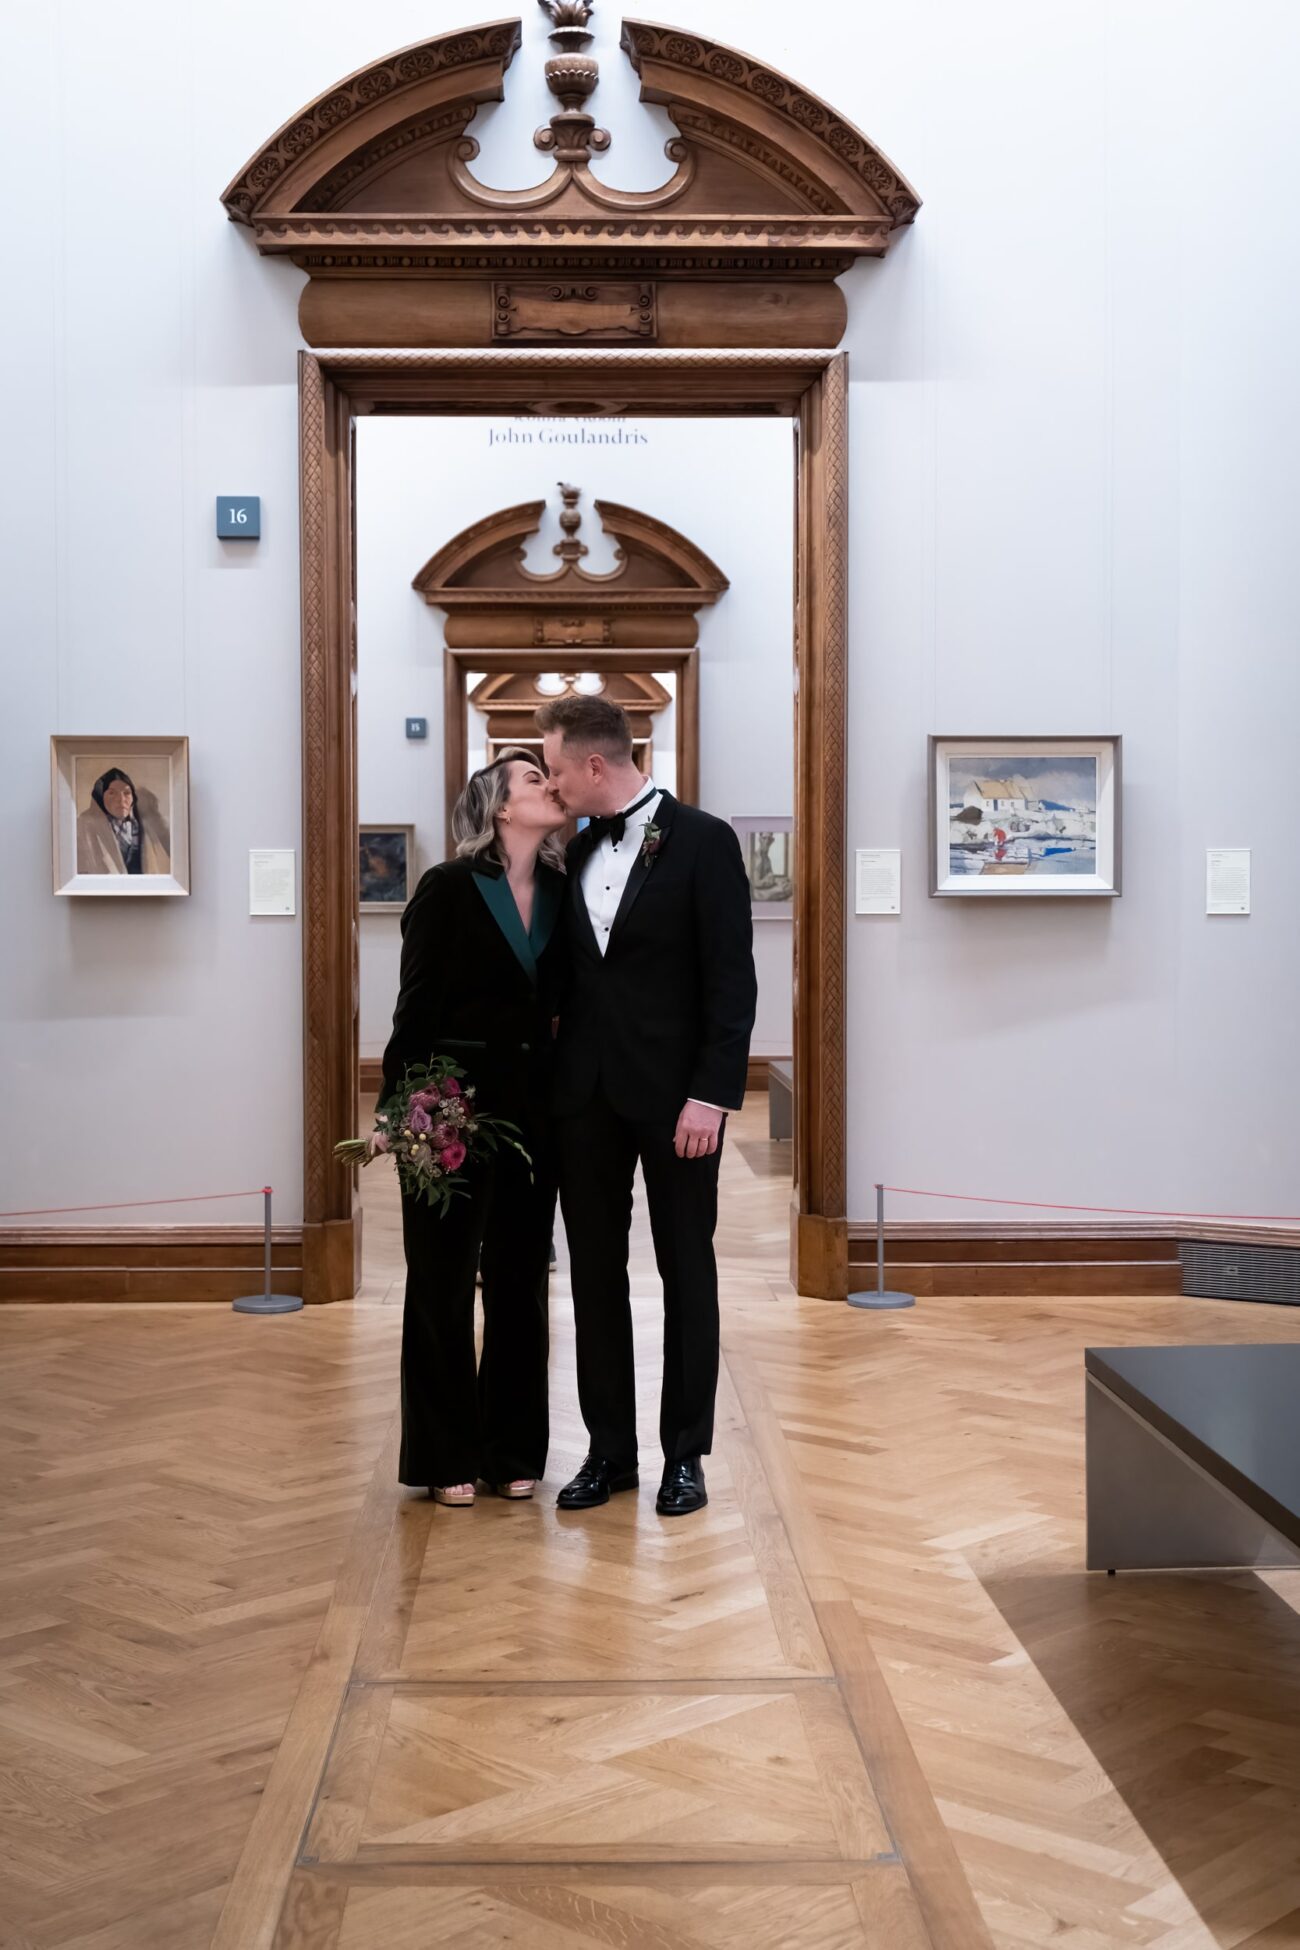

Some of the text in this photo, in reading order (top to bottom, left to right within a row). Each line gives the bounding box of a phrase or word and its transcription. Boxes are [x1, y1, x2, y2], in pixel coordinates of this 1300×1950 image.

[489, 428, 649, 447] John Goulandris
[229, 508, 247, 524] 16
